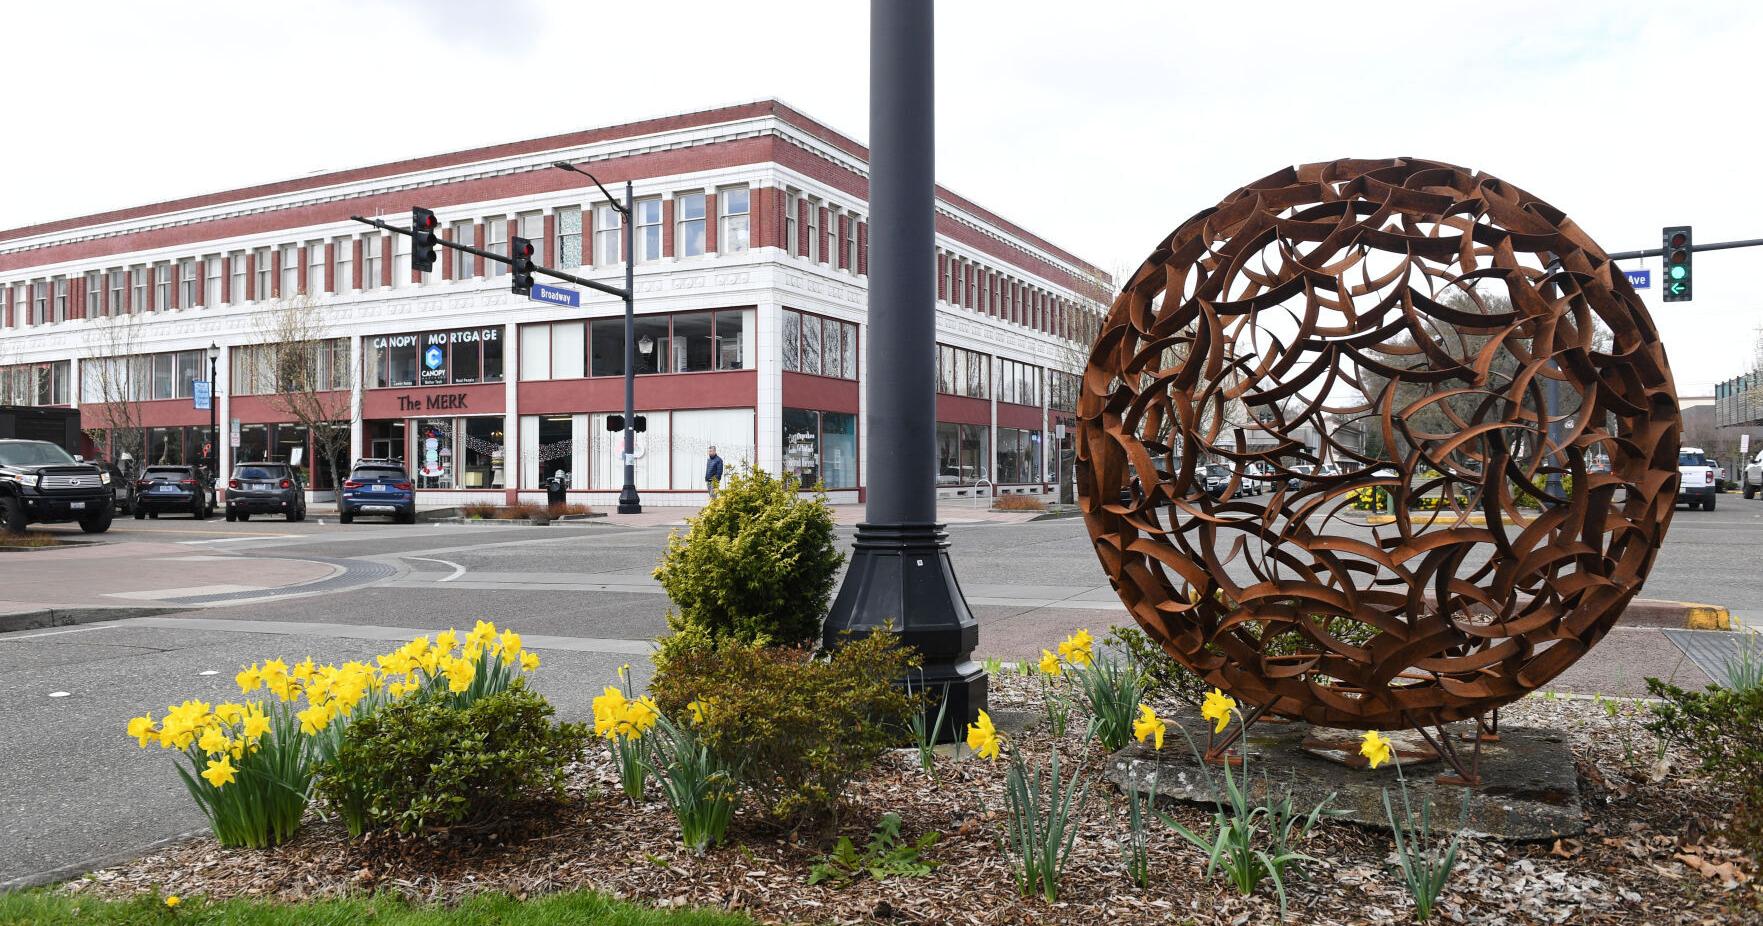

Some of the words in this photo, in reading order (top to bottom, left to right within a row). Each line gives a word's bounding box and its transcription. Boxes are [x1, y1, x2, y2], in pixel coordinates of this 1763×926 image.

[1628, 275, 1646, 285] Ave
[541, 288, 571, 304] Broadway
[373, 335, 417, 348] CANOPY
[428, 329, 497, 345] MORTGAGE
[421, 369, 446, 377] CANOPY
[397, 395, 421, 411] The
[426, 393, 468, 410] MERK
